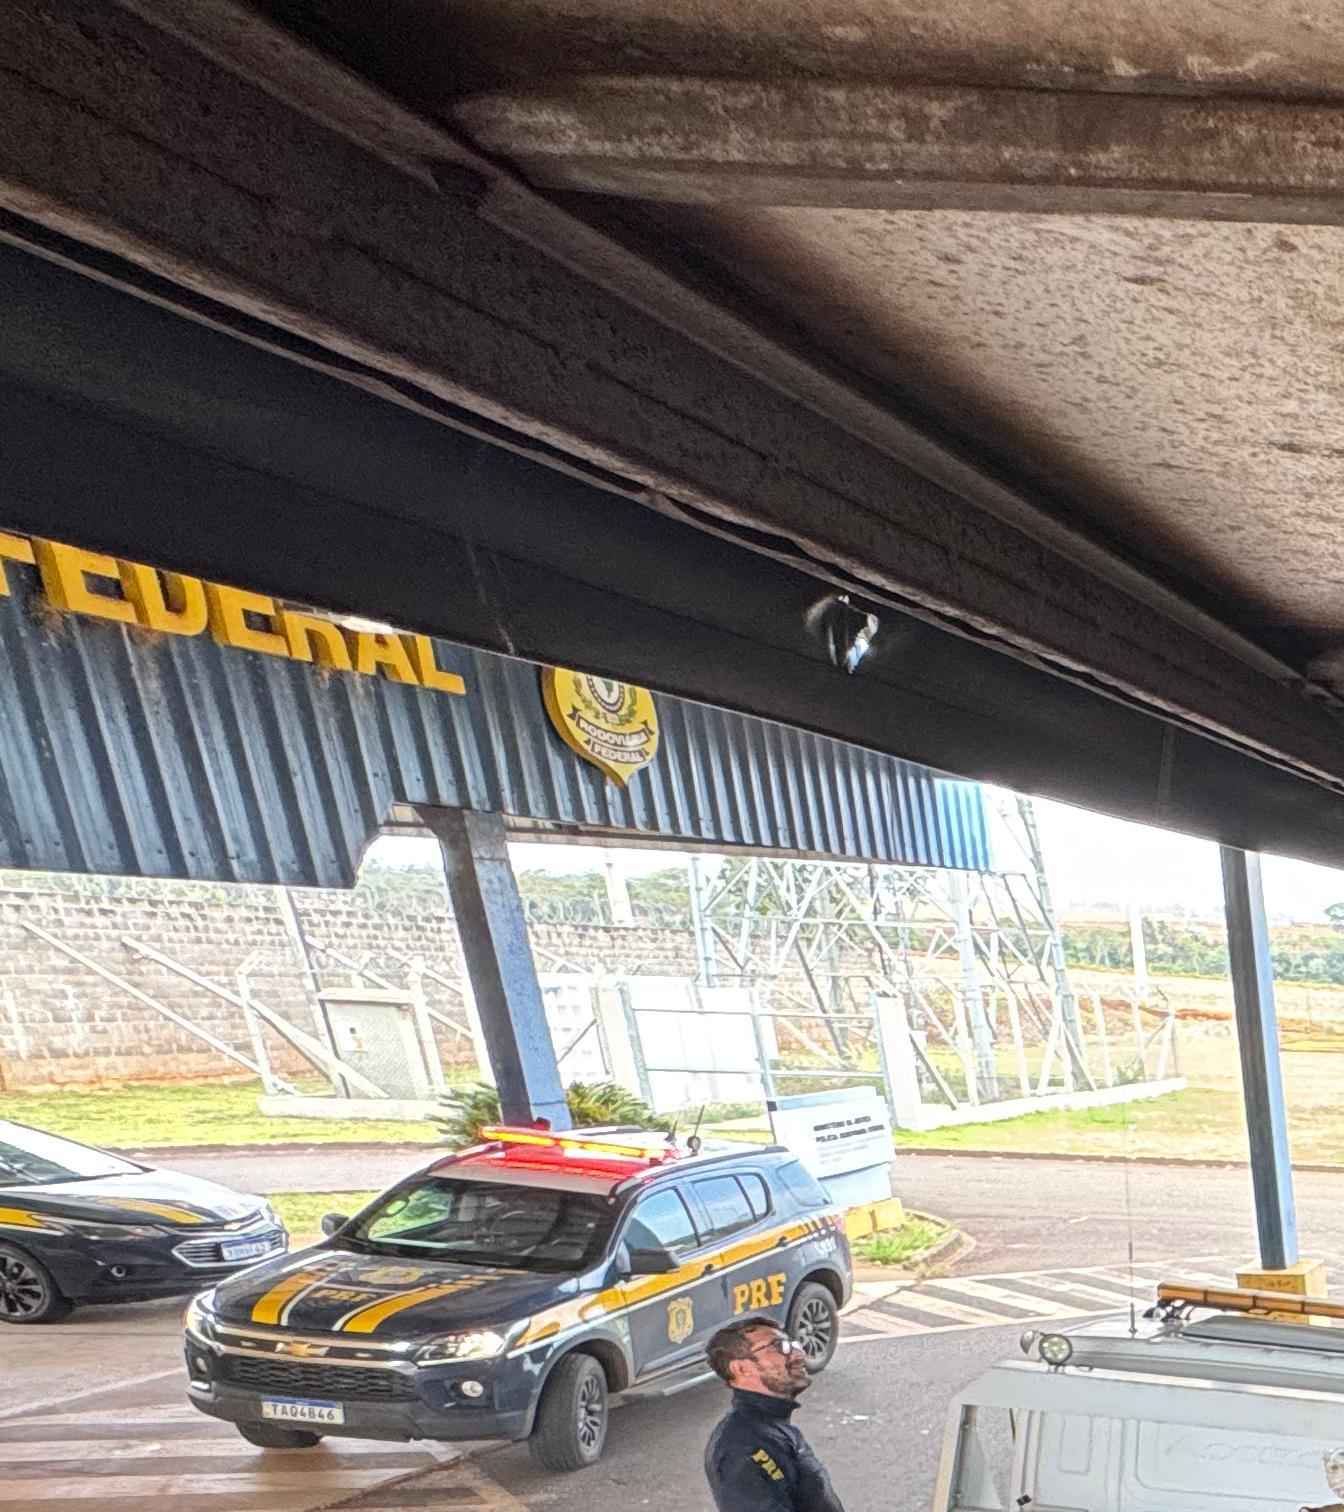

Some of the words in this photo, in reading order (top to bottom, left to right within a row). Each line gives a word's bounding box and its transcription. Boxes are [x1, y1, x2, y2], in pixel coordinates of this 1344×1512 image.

[594, 744, 642, 762] FEDERAL
[732, 1272, 788, 1316] PRF
[271, 1404, 335, 1420] TAQ4B46
[751, 1449, 785, 1481] PRF
